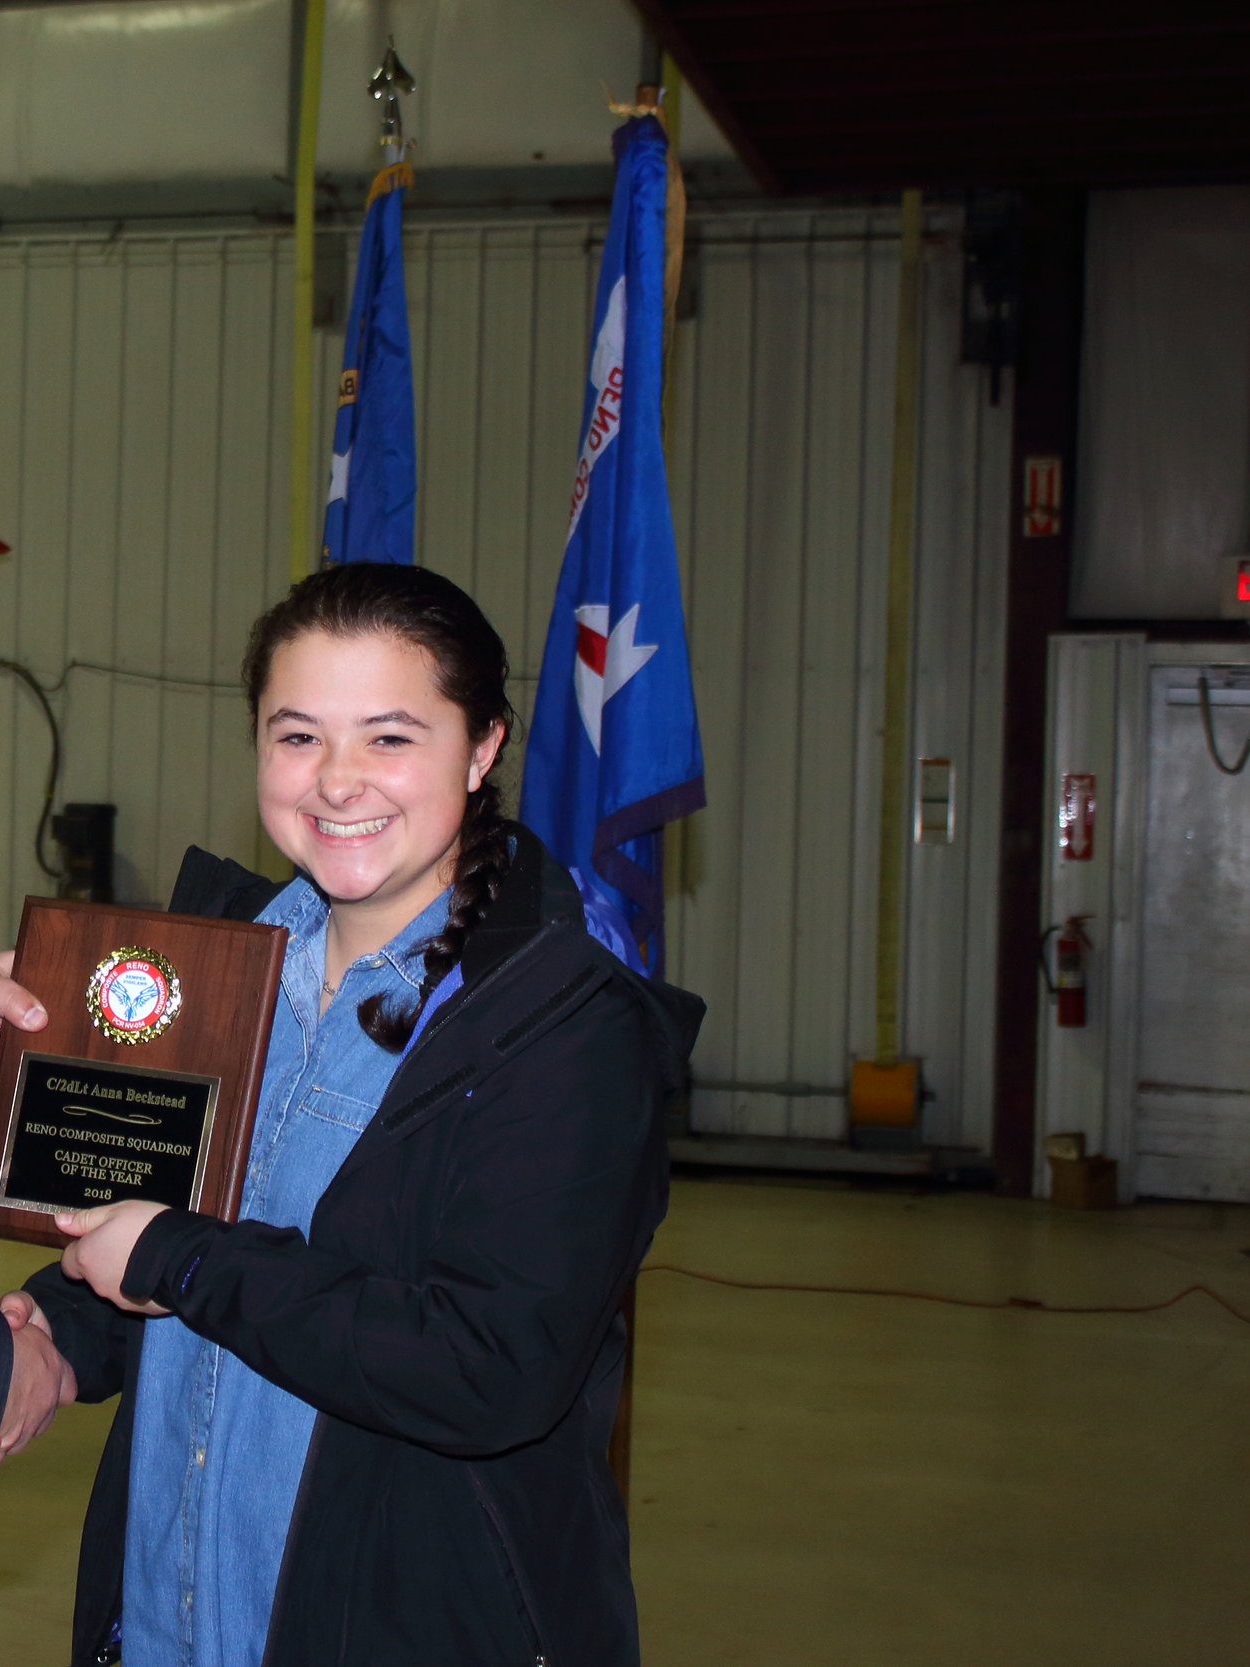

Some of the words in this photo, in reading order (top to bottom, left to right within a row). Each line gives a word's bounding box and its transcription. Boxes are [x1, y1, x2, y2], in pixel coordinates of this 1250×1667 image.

[126, 962, 150, 971] RENO
[101, 971, 119, 1008] COMPOSITE
[154, 976, 166, 1015] SQUADRON
[112, 1016, 124, 1028] PCR
[124, 1020, 146, 1029] NV-054
[46, 1077, 89, 1095] C/2dLt
[91, 1084, 123, 1099] Anna
[126, 1088, 187, 1109] Beckstead
[25, 1122, 57, 1136] RENO
[59, 1127, 125, 1147] COMPOSITE
[126, 1137, 192, 1157] SQUADRON
[54, 1150, 97, 1166] CADET
[98, 1156, 153, 1175] OFFICER
[61, 1163, 78, 1175] OF
[80, 1166, 106, 1181] THE
[109, 1170, 142, 1186] YEAR
[84, 1188, 112, 1200] 2018
